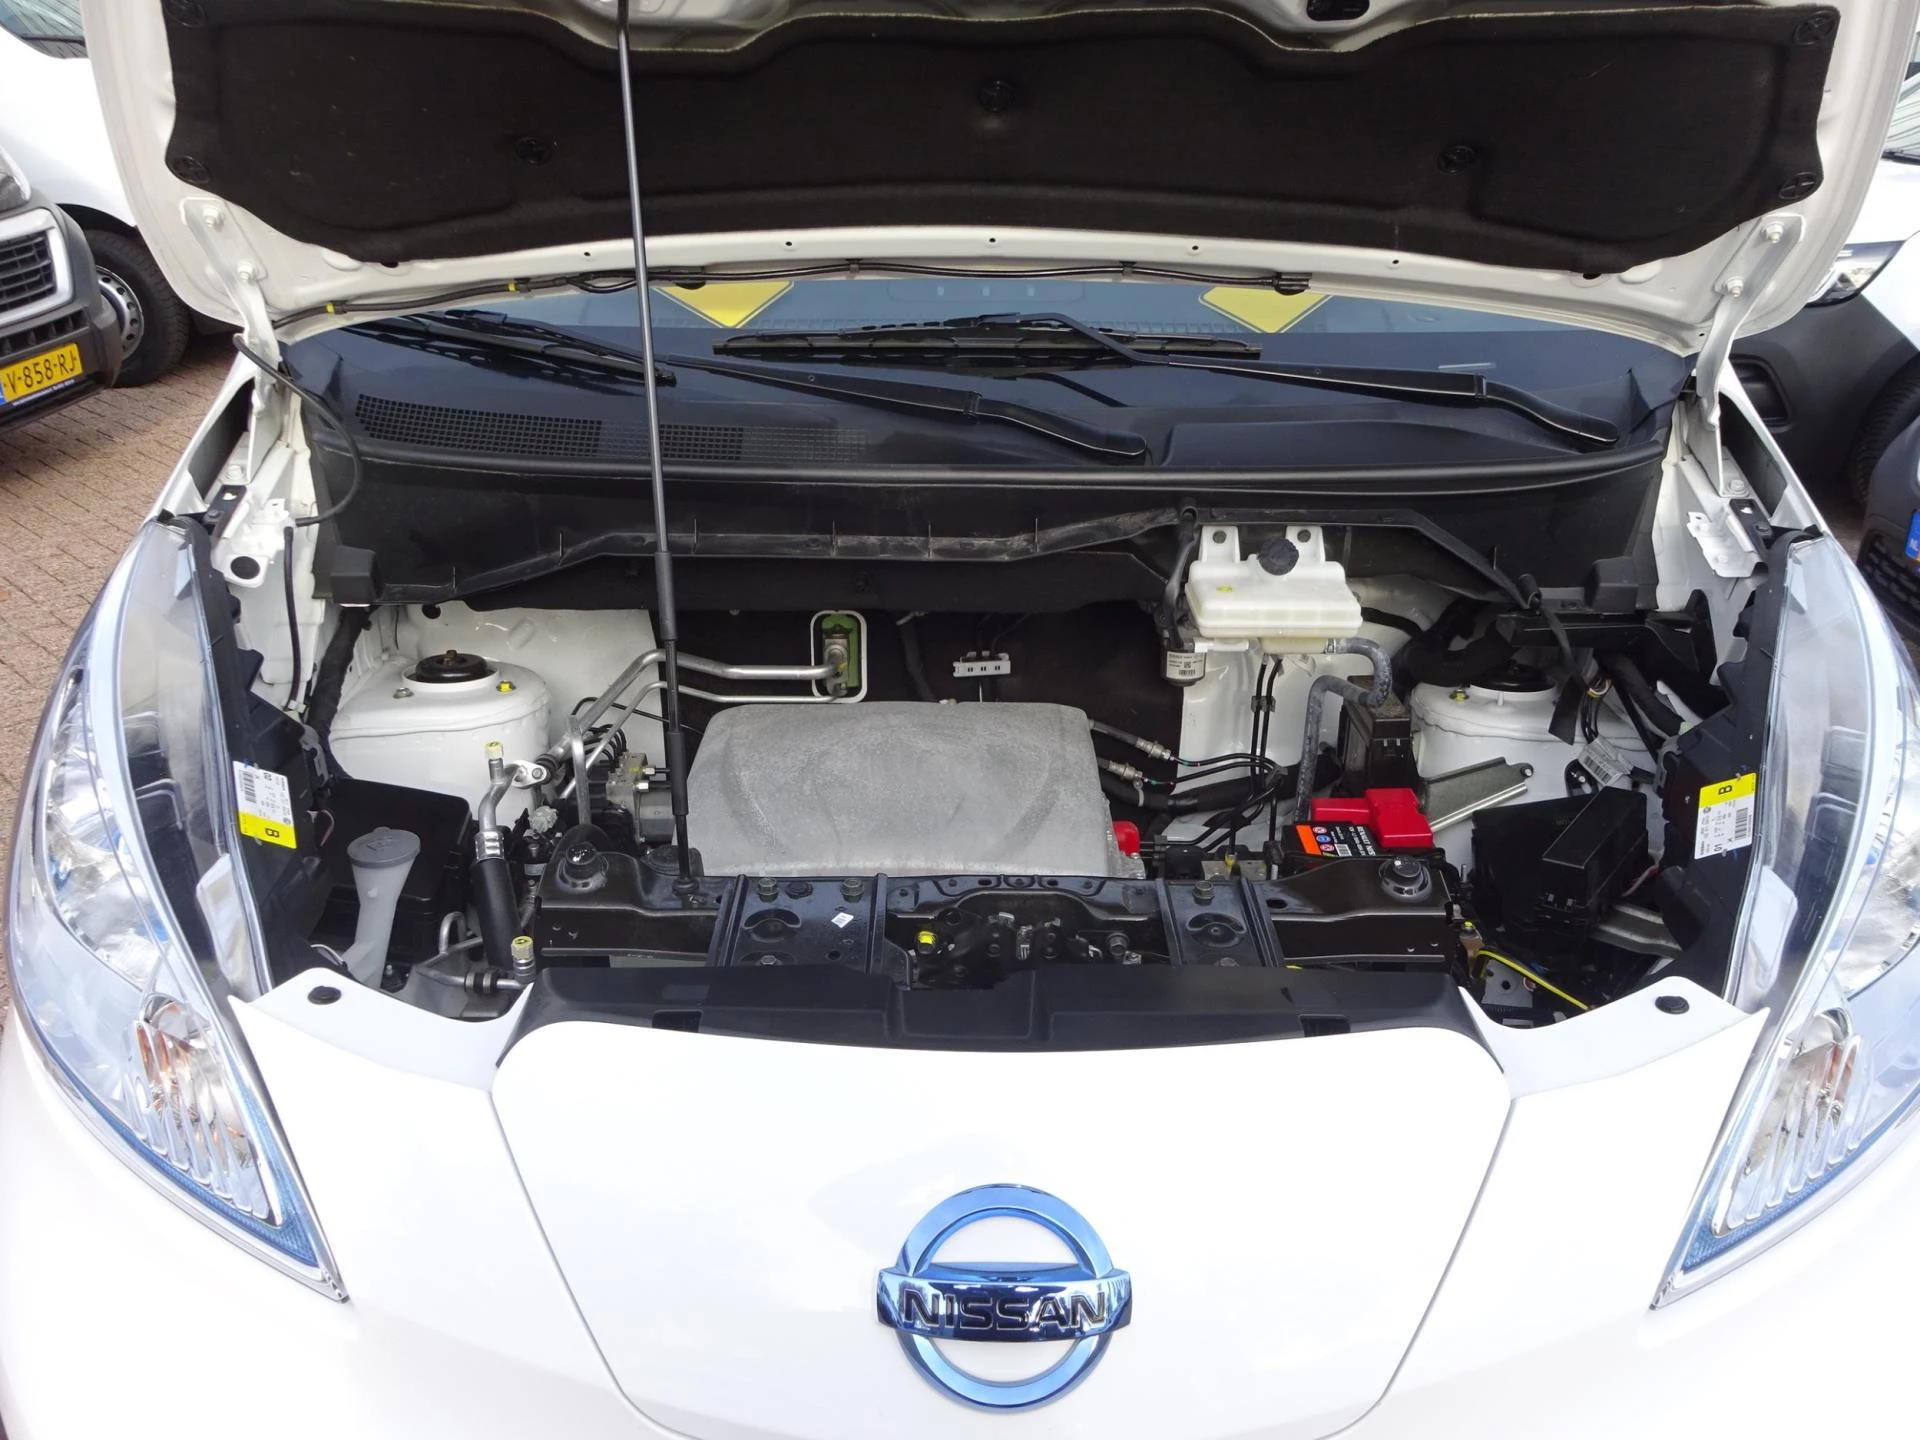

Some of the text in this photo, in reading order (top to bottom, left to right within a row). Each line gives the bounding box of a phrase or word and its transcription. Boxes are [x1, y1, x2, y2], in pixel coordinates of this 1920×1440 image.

[6, 350, 76, 393] V-858-RJ
[1718, 784, 1733, 795] B
[265, 827, 280, 838] B
[904, 1288, 1106, 1331] NISSAN
